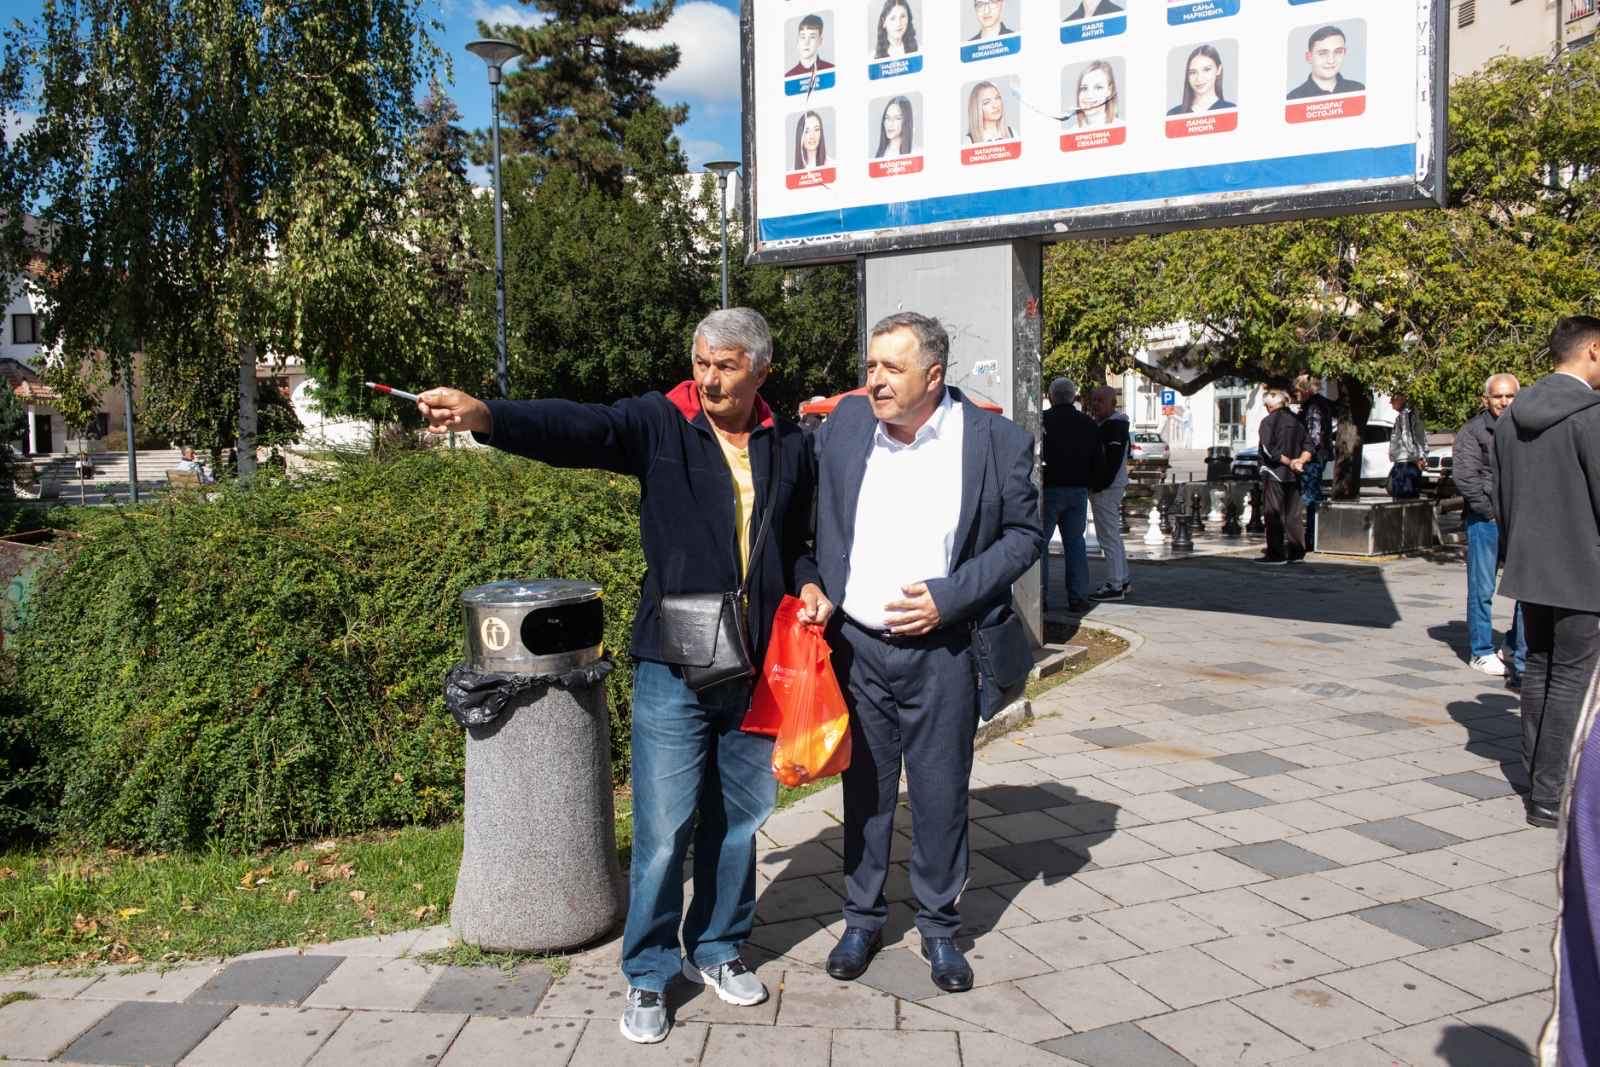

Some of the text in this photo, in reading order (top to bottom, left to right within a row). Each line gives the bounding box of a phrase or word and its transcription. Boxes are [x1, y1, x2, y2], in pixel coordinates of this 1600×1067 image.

[1191, 2, 1215, 13] САЊА
[1182, 7, 1224, 21] МАРКОВИЋ
[1306, 107, 1344, 119] ОСТОЈИЋ
[1164, 392, 1173, 403] P
